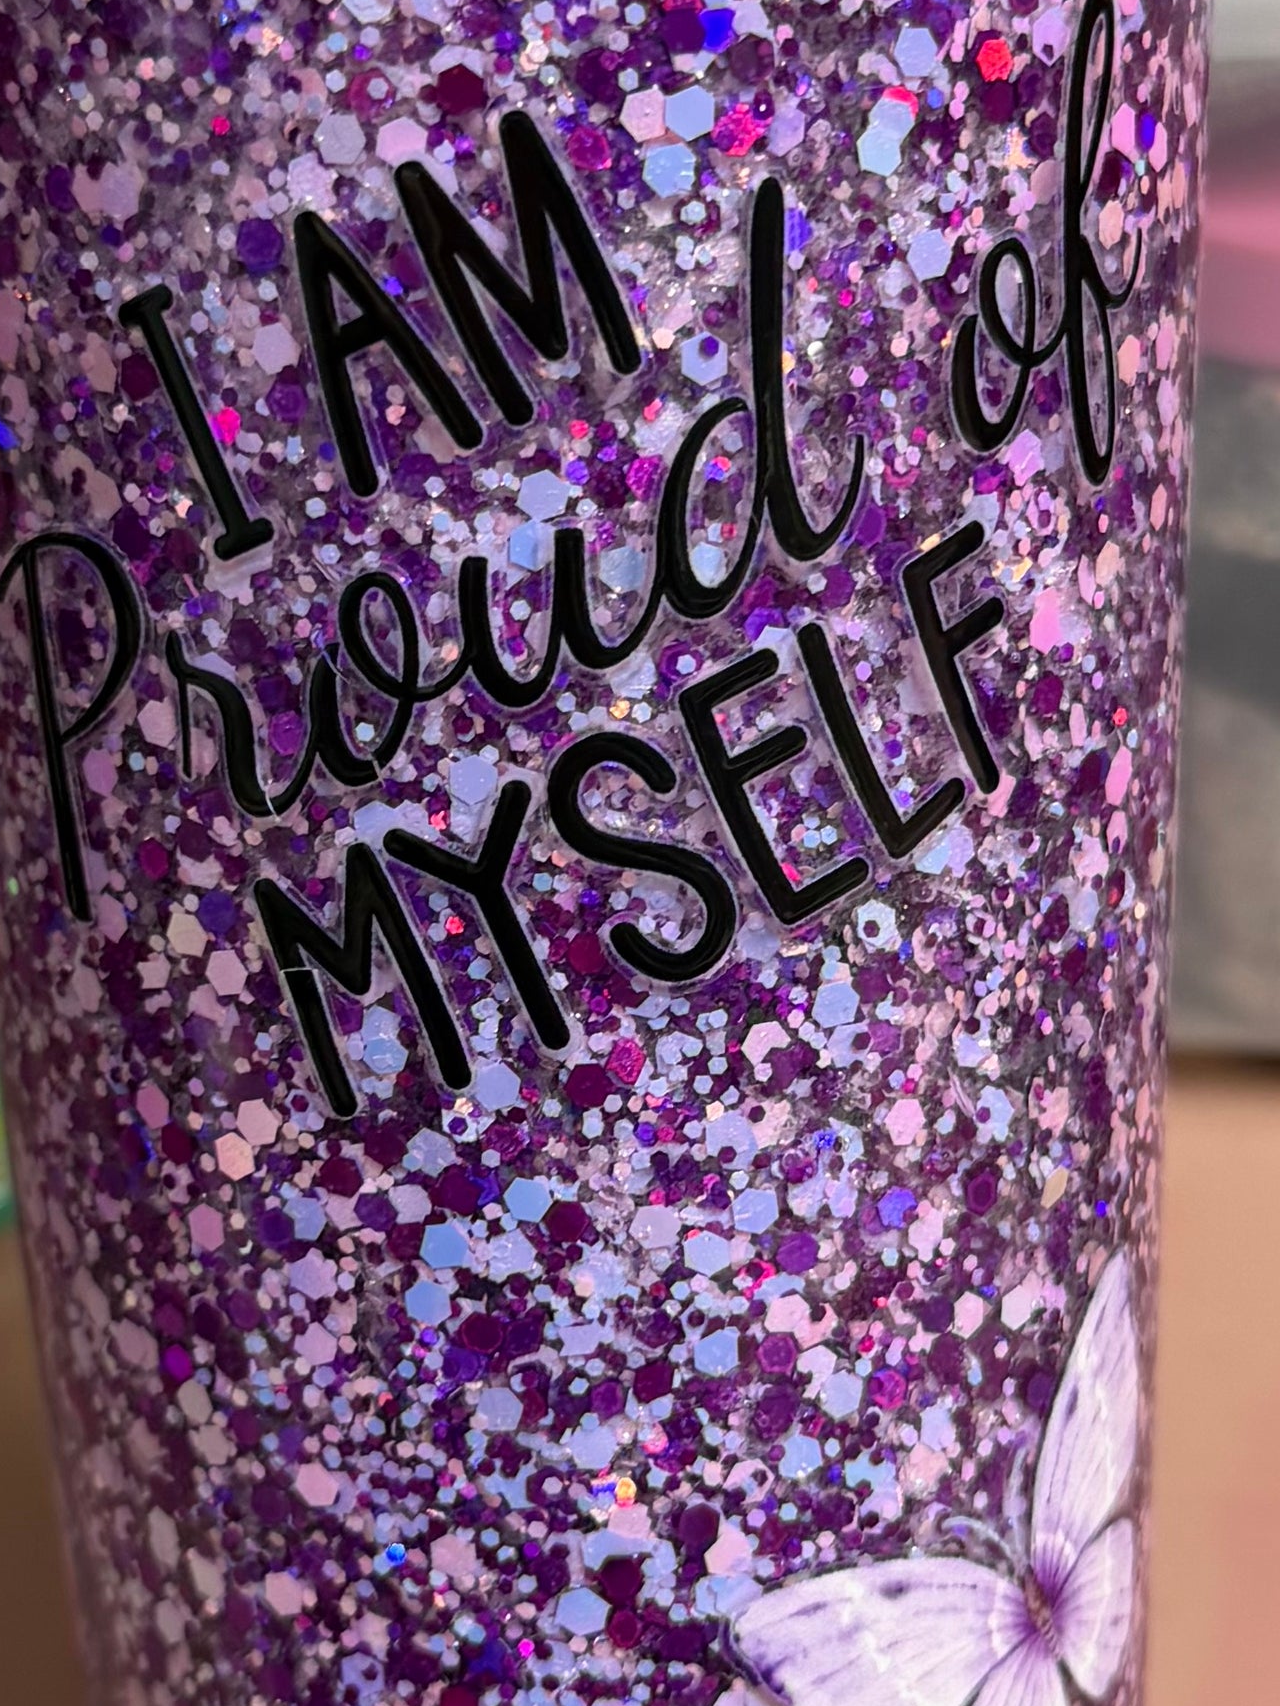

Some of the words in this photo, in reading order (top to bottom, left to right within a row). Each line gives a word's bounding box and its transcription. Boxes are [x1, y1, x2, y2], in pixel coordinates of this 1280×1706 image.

[120, 283, 273, 561] I
[293, 109, 643, 496] AM
[253, 519, 1005, 1118] MYSELF
